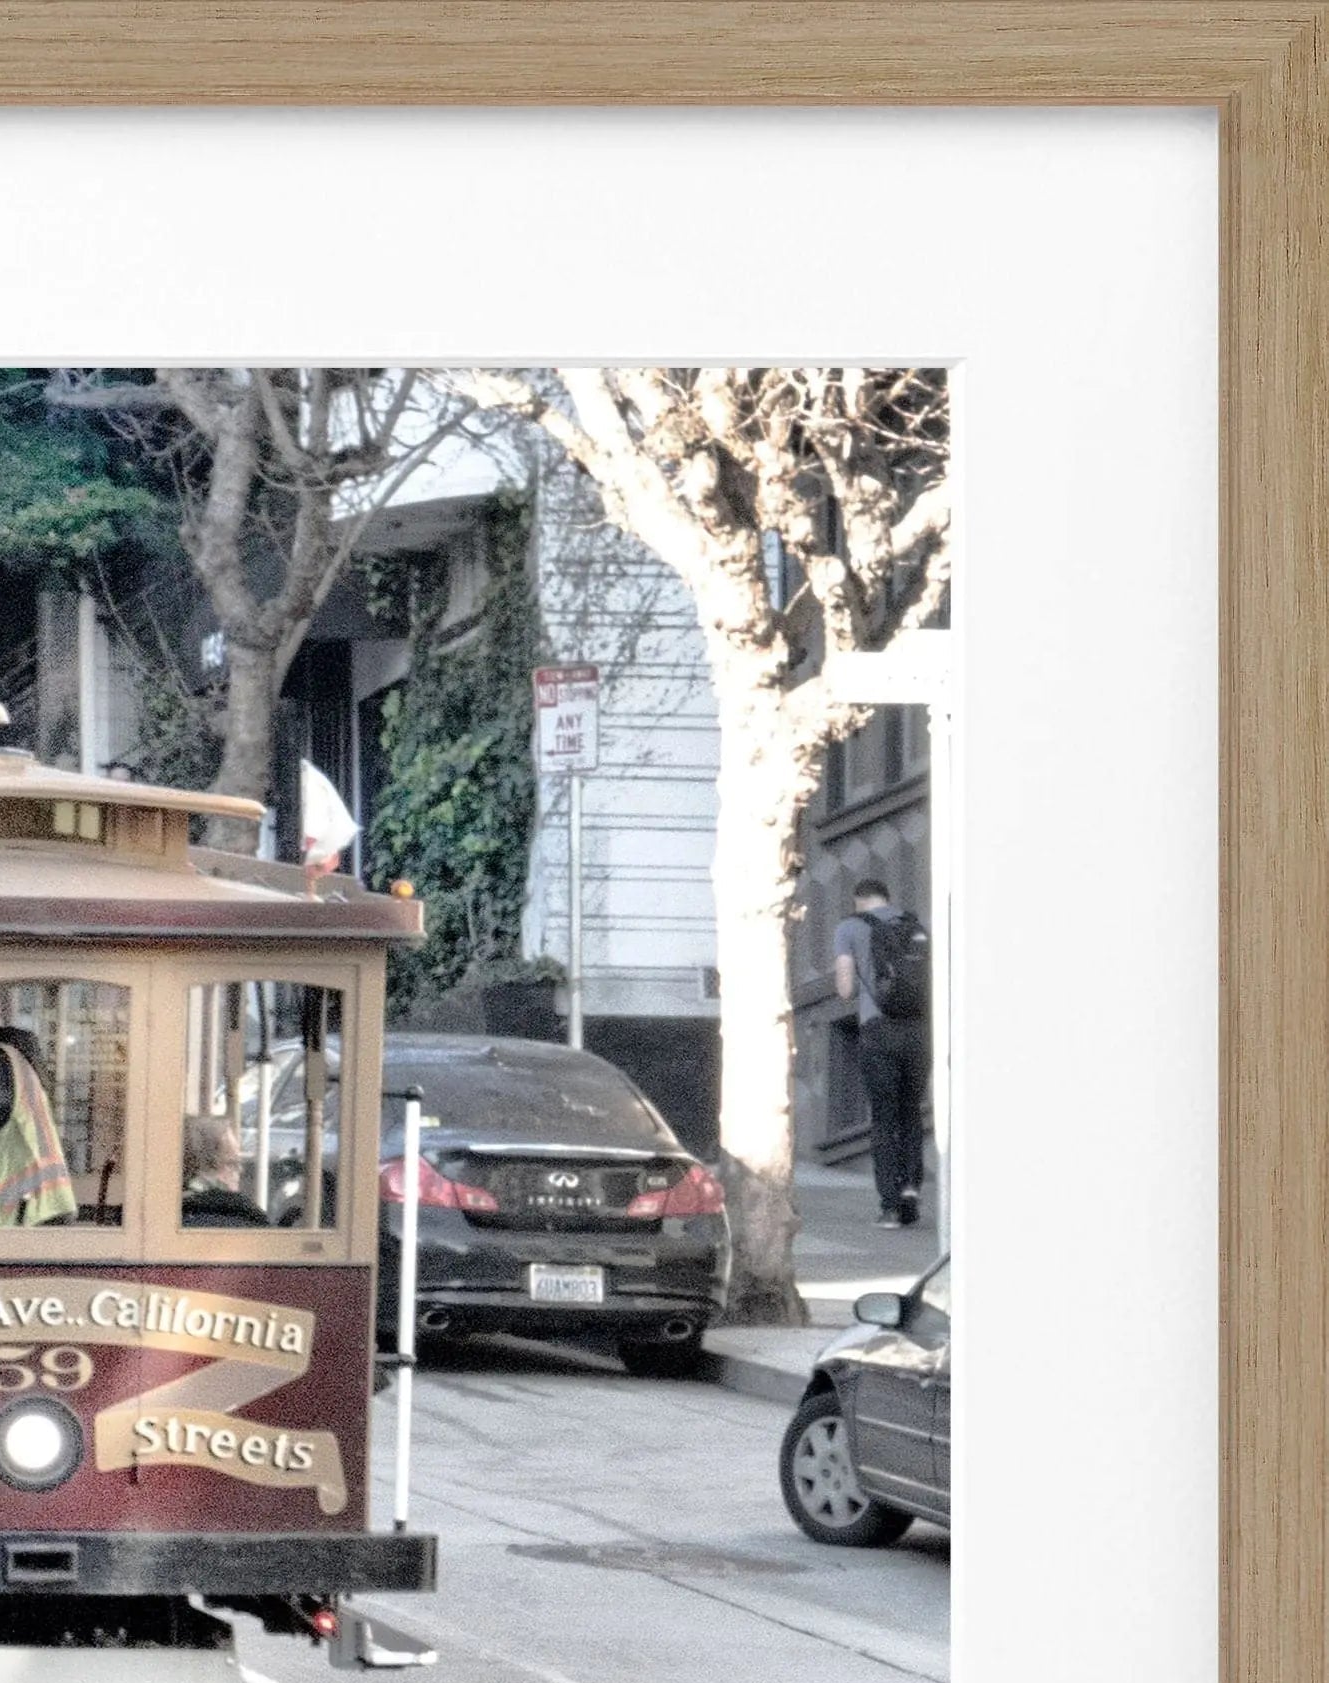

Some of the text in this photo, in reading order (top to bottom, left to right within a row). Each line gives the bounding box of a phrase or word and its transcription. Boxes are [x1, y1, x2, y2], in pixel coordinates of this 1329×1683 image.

[556, 714, 582, 729] ANY
[555, 732, 585, 751] TIME
[89, 1289, 303, 1354] California
[134, 1416, 314, 1471] Streets
